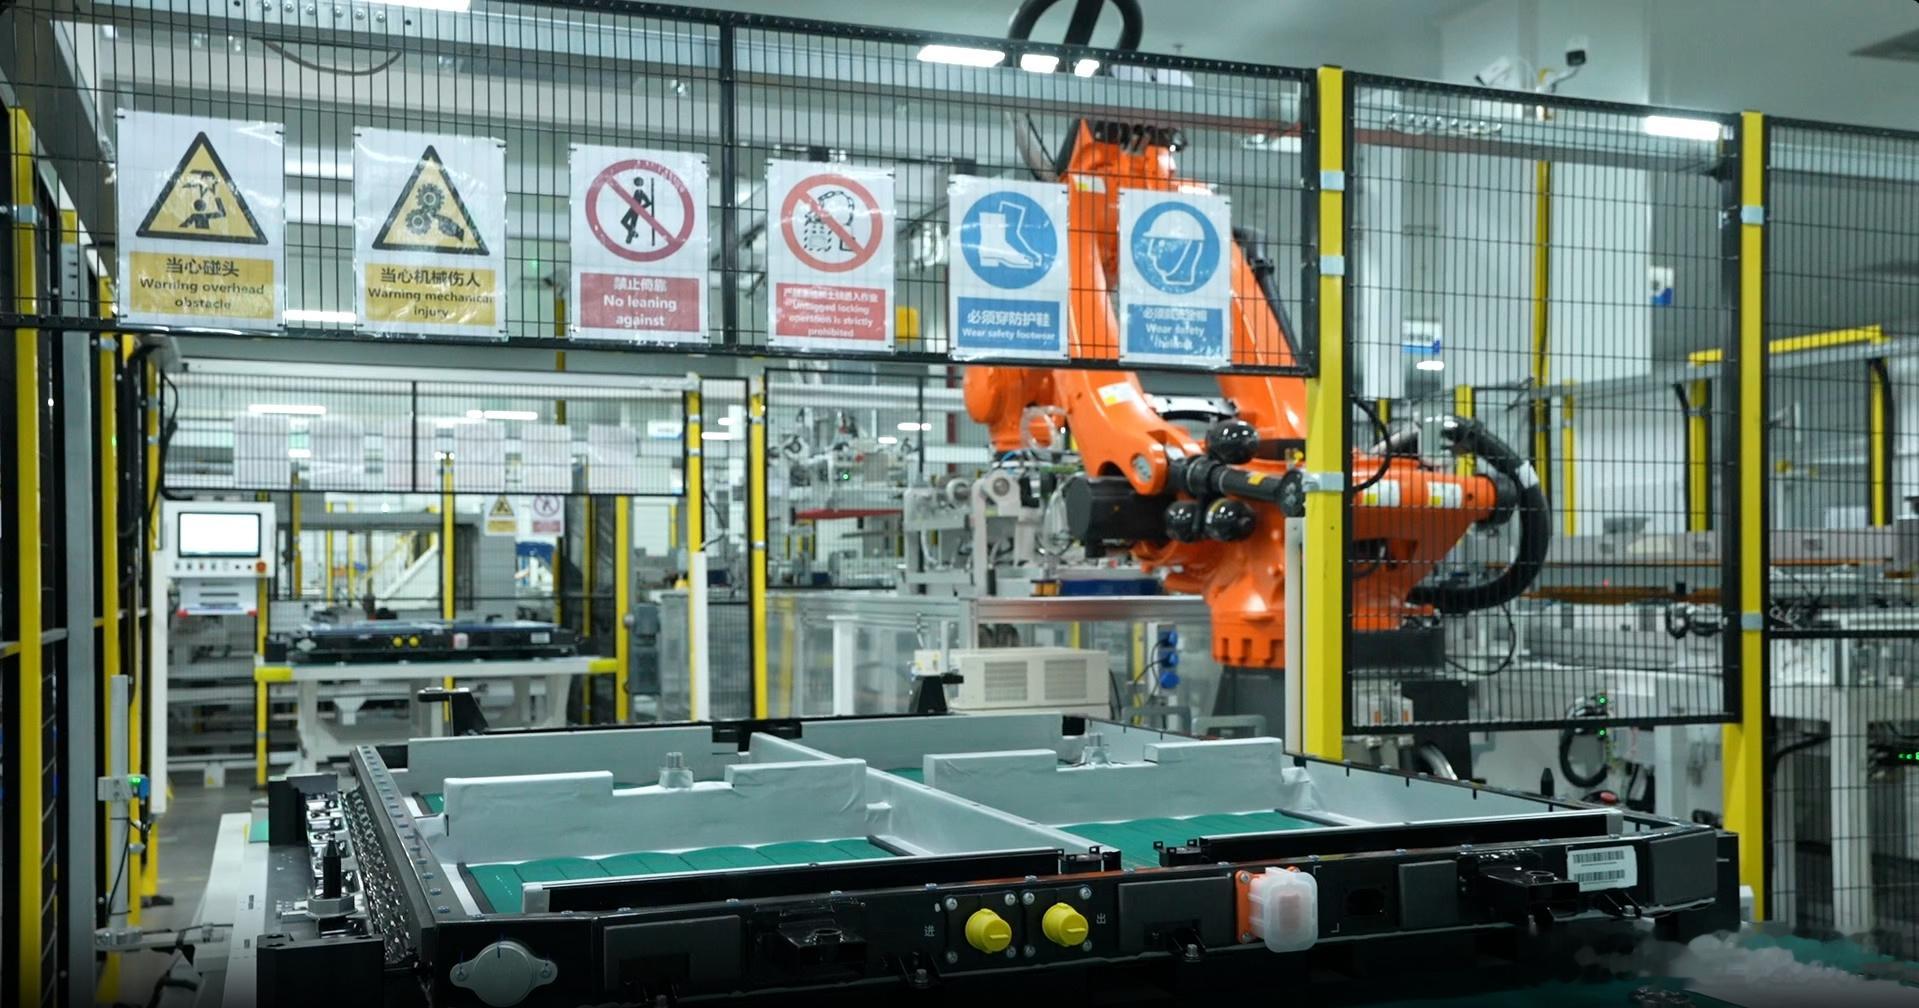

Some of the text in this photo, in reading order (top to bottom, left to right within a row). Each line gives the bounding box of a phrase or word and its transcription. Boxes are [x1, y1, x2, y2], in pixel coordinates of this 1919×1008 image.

[166, 256, 239, 277] 当心碰头
[380, 267, 481, 288] 当心机械伤人
[139, 278, 264, 295] Warning overhead
[368, 287, 421, 301] Warning
[175, 297, 231, 309] obstacle
[603, 294, 677, 312] No leaning
[838, 304, 870, 315] locking
[414, 305, 448, 319] injury
[615, 314, 665, 328] against
[833, 316, 842, 324] is
[843, 317, 874, 328] strictly
[807, 327, 854, 337] prohibited
[962, 328, 985, 337] Wear
[988, 330, 1014, 341] safety
[1145, 323, 1172, 335] Wear
[1096, 913, 1106, 925] 出
